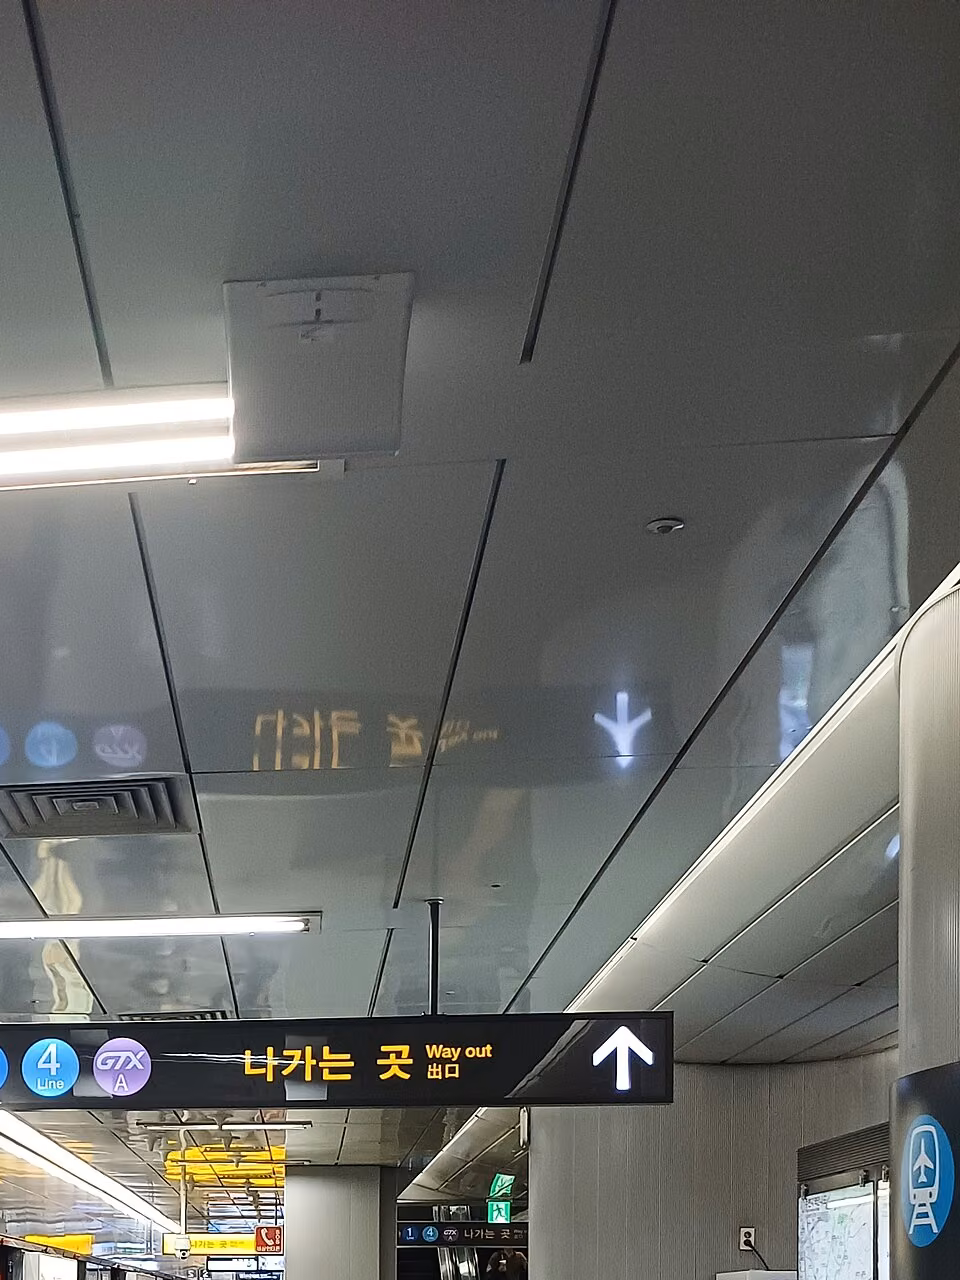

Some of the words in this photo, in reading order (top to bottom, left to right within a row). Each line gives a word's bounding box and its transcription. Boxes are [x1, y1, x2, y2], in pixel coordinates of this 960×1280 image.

[37, 1043, 61, 1076] 4
[96, 1051, 146, 1071] GTX
[425, 1044, 462, 1061] Way
[465, 1043, 493, 1058] out
[244, 1044, 355, 1082] 나가는
[376, 1044, 414, 1080] 곳
[427, 1062, 460, 1080] 出口
[37, 1077, 65, 1091] Line
[113, 1073, 130, 1092] A
[464, 1228, 495, 1239] 나가는
[500, 1228, 510, 1239] 곳
